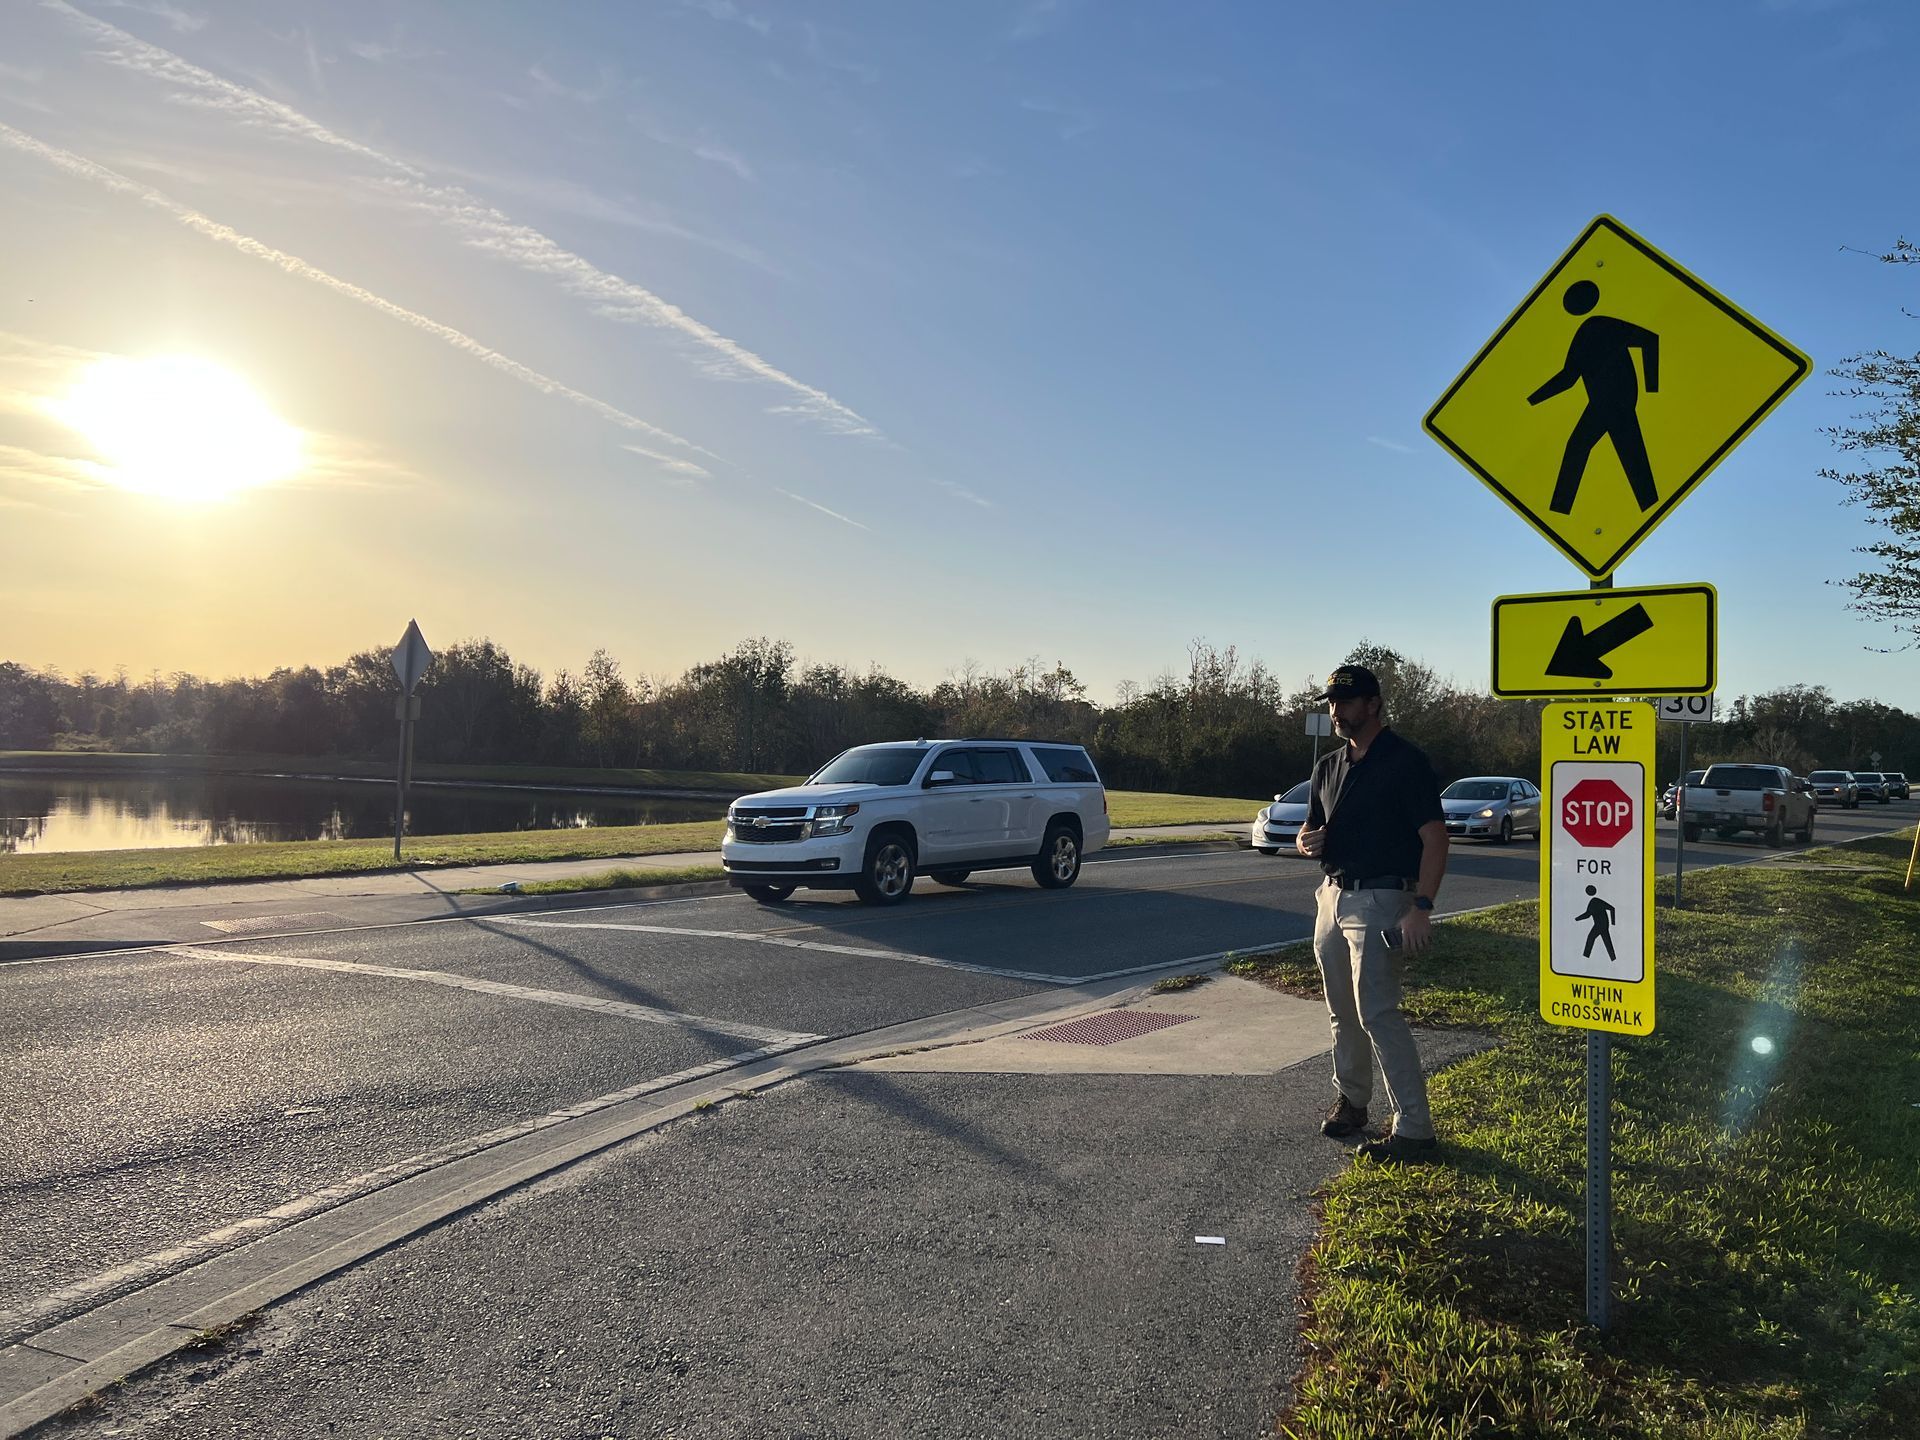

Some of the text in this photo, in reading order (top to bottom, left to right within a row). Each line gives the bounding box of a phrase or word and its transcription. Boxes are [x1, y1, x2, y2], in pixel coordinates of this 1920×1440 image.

[1665, 696, 1707, 715] 30
[1563, 710, 1633, 730] STATE
[1573, 735, 1621, 755] LAW
[1565, 800, 1630, 827] STOP
[1576, 859, 1612, 875] FOR
[1571, 983, 1623, 1004] WITHIN
[1551, 1001, 1642, 1027] CROSSWALK
